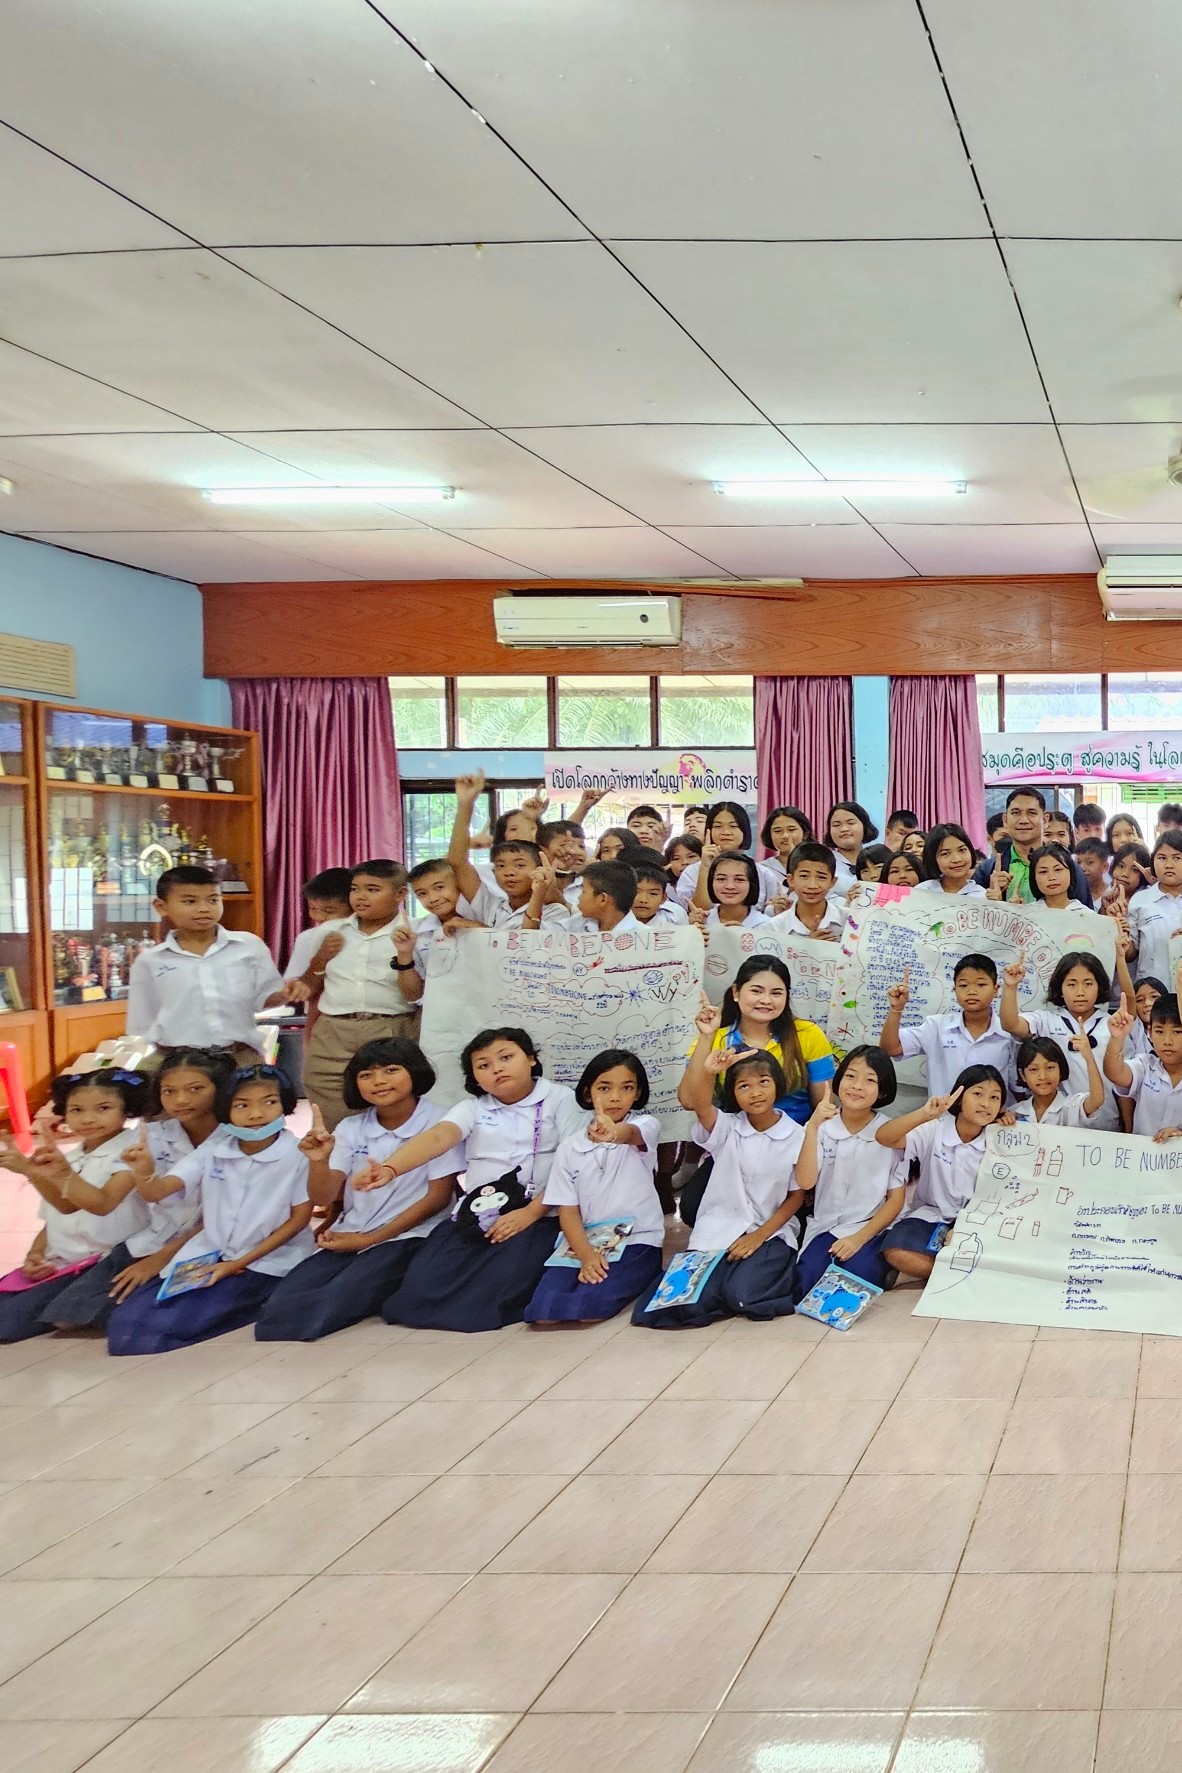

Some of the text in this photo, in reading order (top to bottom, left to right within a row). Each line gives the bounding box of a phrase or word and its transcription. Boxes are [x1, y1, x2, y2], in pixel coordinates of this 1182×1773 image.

[997, 1130, 1022, 1150] กลุ่ม
[1075, 1144, 1102, 1167] TO
[1114, 1147, 1132, 1170] BE
[1161, 1203, 1171, 1214] BE
